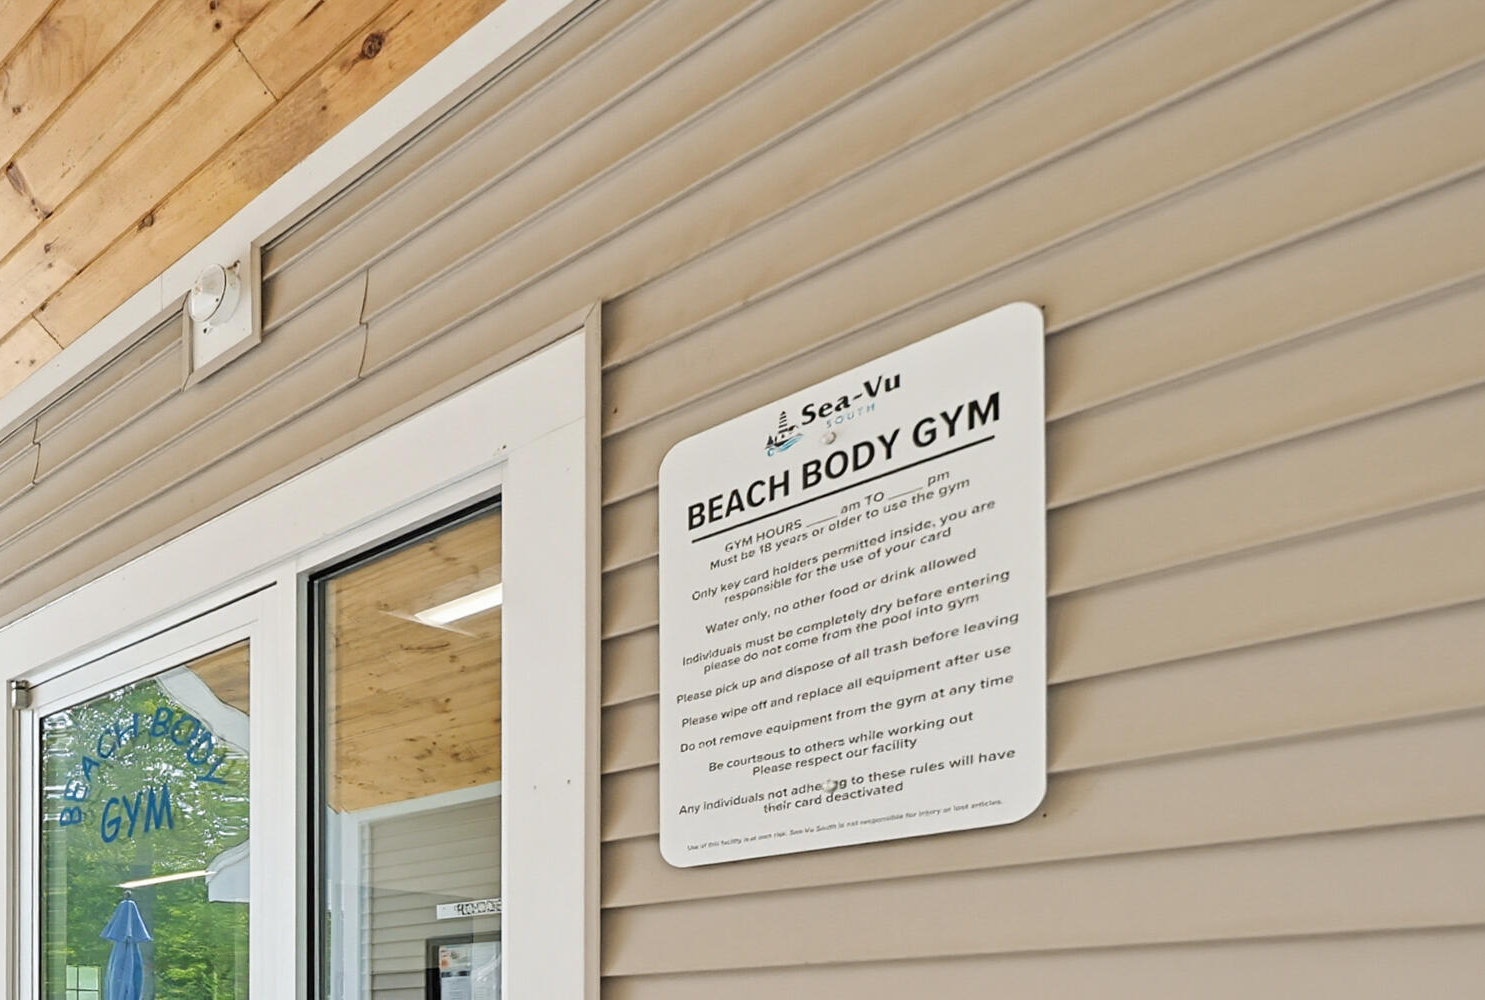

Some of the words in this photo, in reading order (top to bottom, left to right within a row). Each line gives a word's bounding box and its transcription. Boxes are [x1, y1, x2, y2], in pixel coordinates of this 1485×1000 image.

[800, 372, 901, 426] Sea-Vu
[826, 402, 875, 429] SOUTH
[687, 469, 789, 531] BEACH
[802, 427, 900, 490] BODY
[912, 391, 1000, 448] GYM
[691, 586, 718, 601] Only
[719, 579, 741, 592] key
[743, 569, 769, 585] card
[772, 555, 818, 576] holders
[821, 532, 886, 563] permitted
[889, 519, 936, 540] inside,
[939, 508, 967, 527] you
[971, 500, 995, 514] are
[709, 553, 737, 570] Must
[740, 549, 756, 560] be
[759, 541, 772, 554] 18
[774, 532, 808, 552] years
[811, 526, 824, 537] or
[828, 513, 862, 531] older
[865, 508, 879, 519] to
[882, 499, 907, 513] use
[911, 490, 935, 504] the
[938, 478, 970, 498] gym
[724, 535, 753, 552] GYM
[755, 518, 802, 543] HOURS
[839, 500, 861, 514] am
[863, 490, 885, 505] TO
[927, 470, 950, 487] pm
[704, 618, 739, 634] Water
[741, 610, 770, 624] only,
[773, 604, 789, 615] no
[792, 593, 825, 610] other
[828, 581, 859, 599] food
[862, 578, 877, 589] or
[880, 566, 915, 584] drink
[919, 547, 976, 574] allowed
[723, 577, 792, 604] responsible
[794, 569, 813, 582] for
[815, 563, 837, 576] the
[840, 554, 864, 569] use
[867, 546, 881, 560] of
[884, 538, 916, 558] your
[919, 526, 951, 544] card
[676, 688, 712, 704] Please
[714, 680, 739, 696] pick
[741, 678, 757, 689] up
[759, 669, 783, 684] and
[785, 659, 834, 677] dispose
[837, 651, 851, 665] of
[854, 647, 870, 661] all
[872, 639, 908, 656] trash
[912, 627, 959, 647] before
[963, 612, 1019, 634] leaving
[682, 642, 742, 666] Individuals
[745, 633, 774, 649] must
[777, 629, 793, 640] be
[795, 608, 867, 635] completely
[870, 602, 893, 615] dry
[896, 588, 942, 608] before
[946, 570, 1010, 595] entering
[703, 656, 741, 675] please
[743, 651, 758, 662] do
[761, 644, 782, 657] not
[784, 635, 819, 651] come
[822, 627, 852, 642] from
[855, 620, 878, 633] the
[881, 608, 912, 629] pool
[915, 603, 943, 617] into
[947, 593, 979, 611] gym
[679, 742, 696, 753] Do
[698, 736, 717, 749] not
[719, 728, 763, 744] remove
[765, 712, 832, 735] equipment
[835, 706, 866, 720] from
[869, 700, 892, 712] the
[895, 693, 926, 710] gym
[930, 688, 945, 700] at
[948, 682, 976, 696] any
[979, 674, 1014, 689] time
[681, 712, 718, 728] Please
[720, 705, 748, 719] wipe
[750, 699, 768, 712] off
[770, 692, 793, 708] and
[796, 683, 843, 702] replace
[846, 676, 862, 690] all
[865, 659, 941, 686] equipment
[944, 651, 980, 668] after
[984, 645, 1011, 659] use
[59, 713, 140, 827] BEACH
[150, 706, 228, 785] BODY
[678, 804, 701, 815] Any
[702, 792, 765, 810] individuals
[767, 787, 788, 800] not
[790, 778, 847, 796] adheg
[850, 775, 864, 785] to
[867, 768, 906, 783] these
[909, 761, 945, 775] rules
[948, 753, 974, 768] will
[978, 749, 1016, 763] have
[708, 761, 724, 772] Be
[788, 746, 801, 756] to
[804, 738, 845, 753] others
[847, 729, 884, 744] while
[887, 718, 945, 737] working
[948, 710, 973, 725] out
[752, 761, 792, 776] Please
[795, 751, 843, 768] respect
[845, 746, 869, 758] our
[871, 737, 917, 754] facility
[101, 783, 175, 843] GYM
[763, 799, 792, 814] their
[794, 793, 822, 808] card
[825, 780, 903, 803] deactivated
